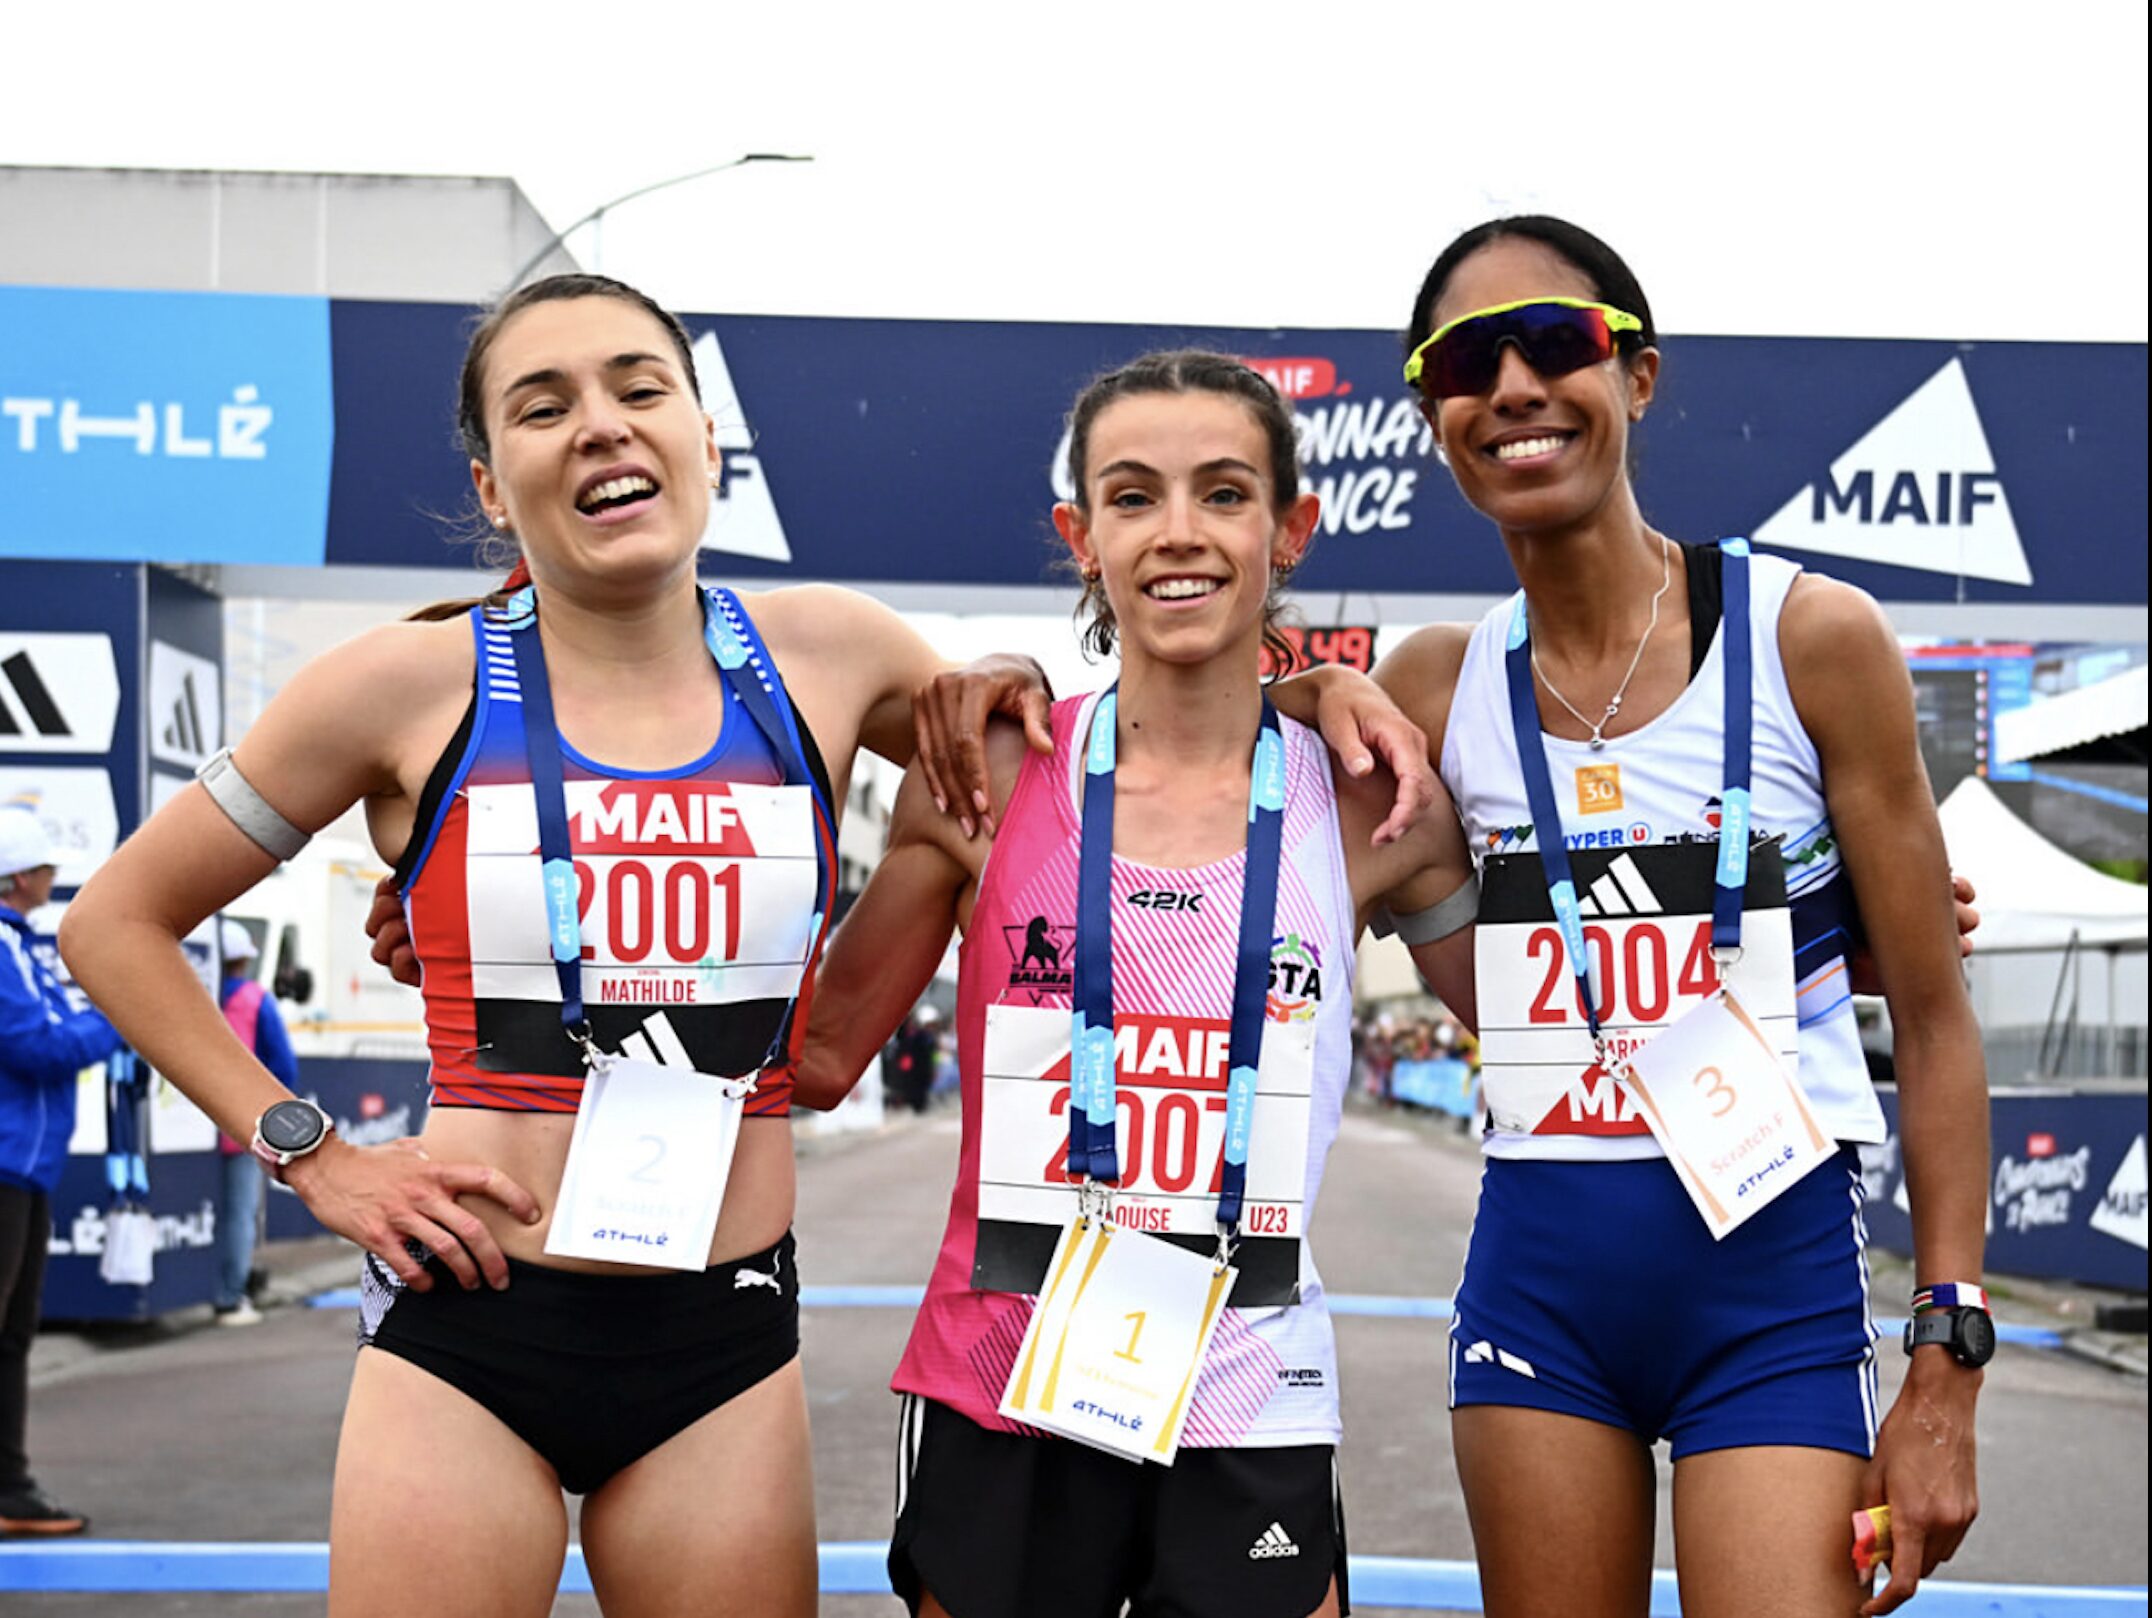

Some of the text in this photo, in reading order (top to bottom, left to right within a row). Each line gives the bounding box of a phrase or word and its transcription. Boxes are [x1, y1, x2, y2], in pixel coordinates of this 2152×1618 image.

[1251, 365, 1314, 395] AIF
[1299, 466, 1418, 536] NCE
[1807, 469, 1996, 526] MAIF
[576, 792, 738, 845] MAIF
[1127, 889, 1204, 913] 42K
[601, 979, 697, 1004] MATHILDE
[1526, 922, 1721, 1024] 2004
[1693, 1065, 1737, 1118] 3
[629, 1134, 667, 1184] 2
[1106, 1205, 1288, 1233] OUISE U23
[1113, 1310, 1146, 1365] 1
[1247, 1543, 1300, 1560] adidas
